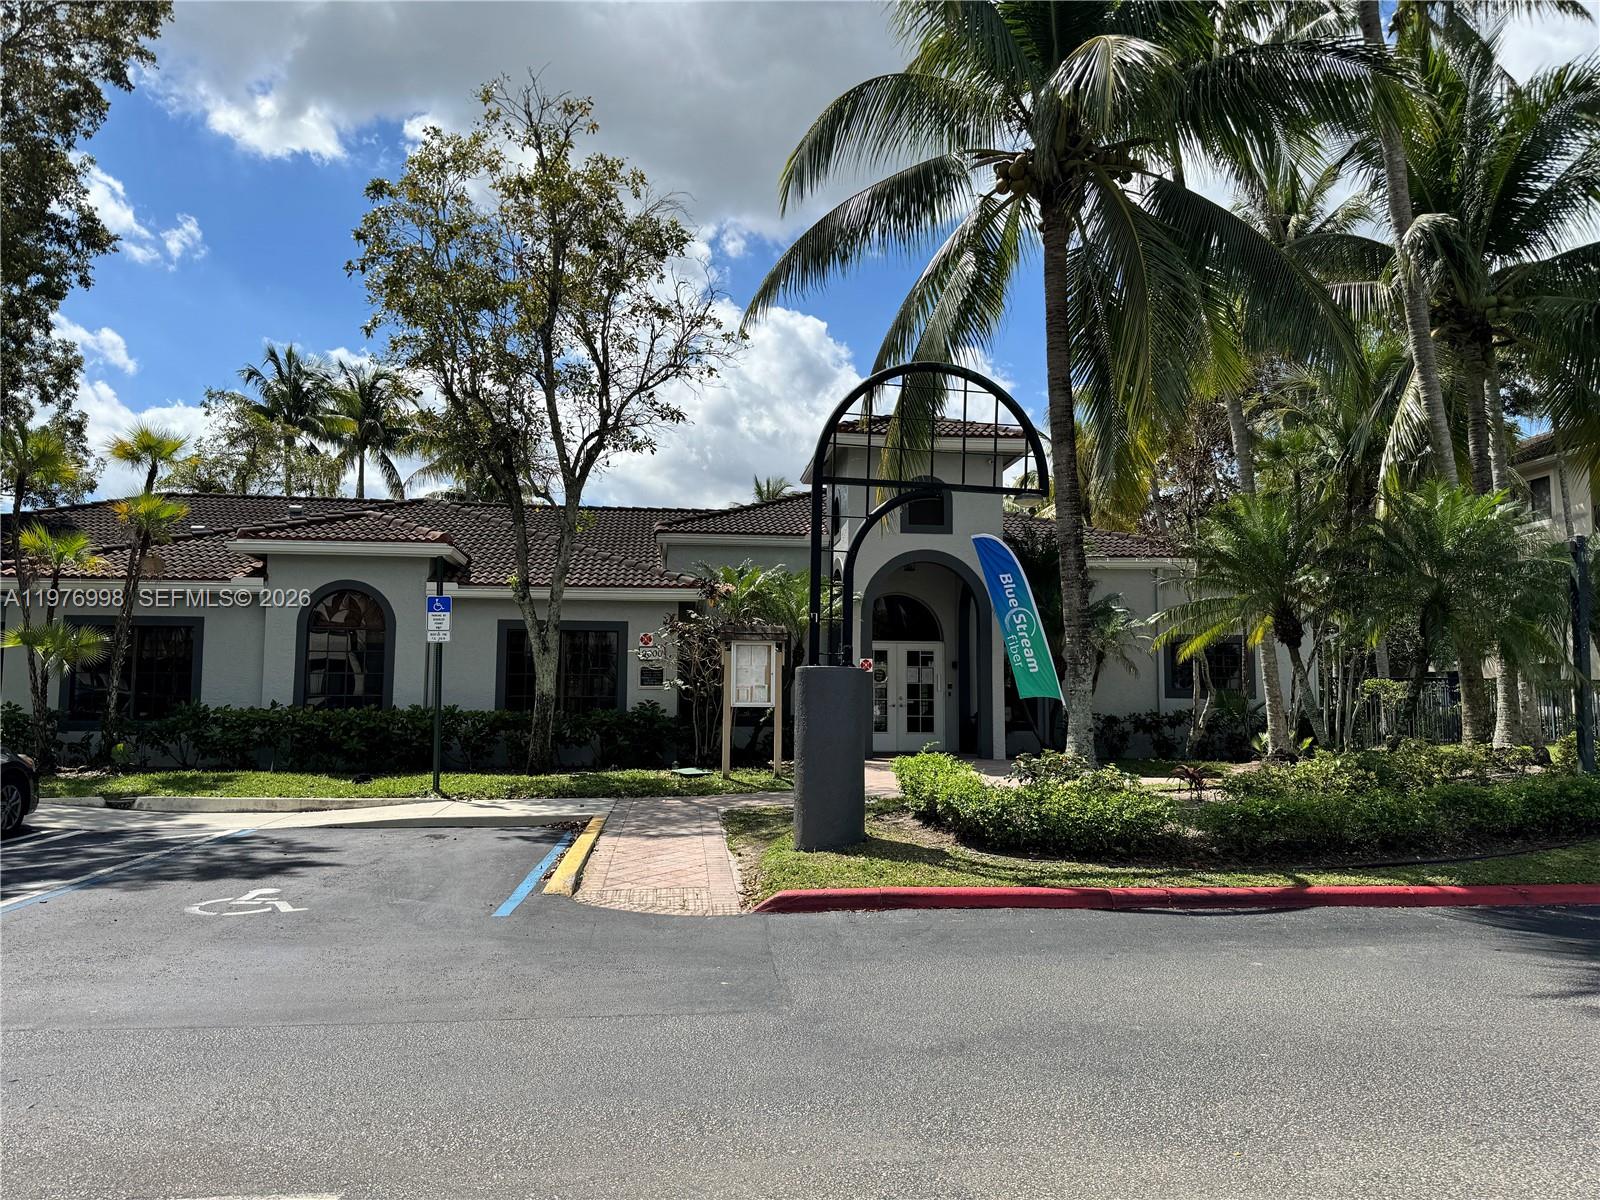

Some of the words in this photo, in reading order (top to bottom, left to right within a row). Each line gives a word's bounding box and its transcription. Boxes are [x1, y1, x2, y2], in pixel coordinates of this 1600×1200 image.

[999, 573, 1018, 607] Blue
[1012, 614, 1039, 673] Stream
[1007, 634, 1023, 668] fiber
